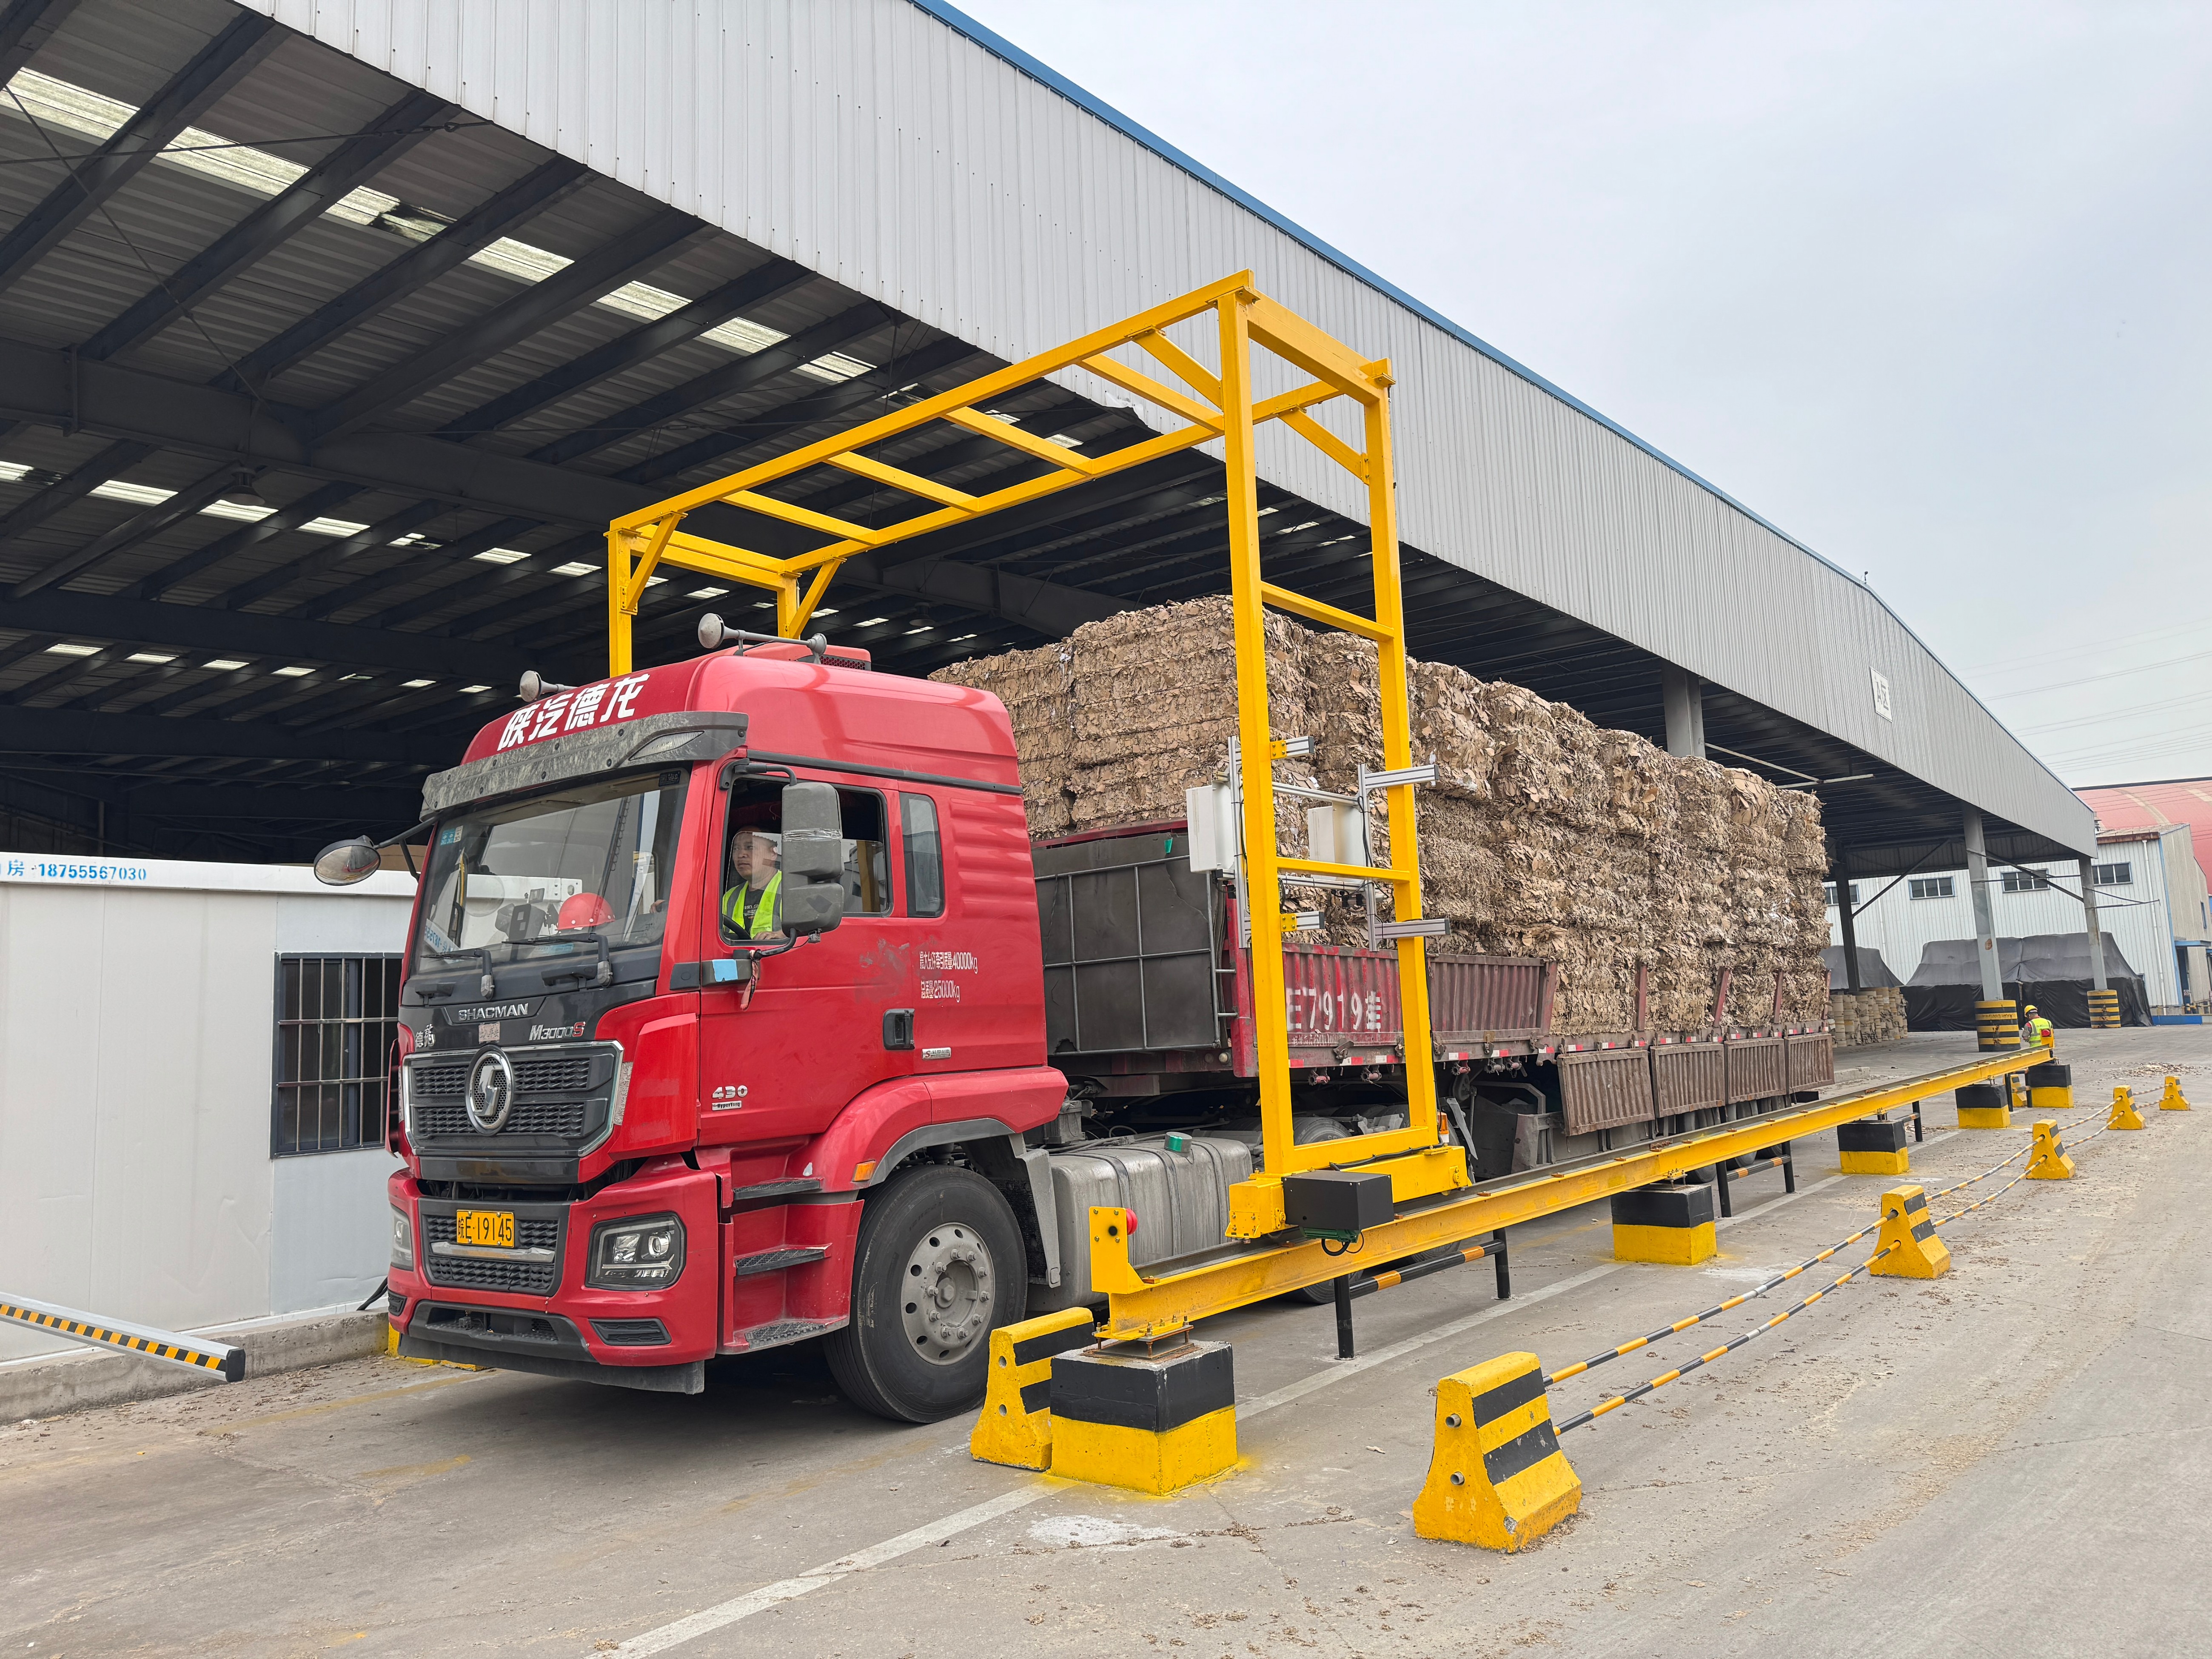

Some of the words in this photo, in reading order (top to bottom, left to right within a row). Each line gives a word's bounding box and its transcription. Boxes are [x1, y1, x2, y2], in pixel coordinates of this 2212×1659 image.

[496, 673, 650, 751] 陕汽德龙
[0, 859, 25, 876] 房
[39, 864, 146, 880] 18755567030
[458, 1003, 529, 1021] SHACMAN
[529, 1021, 586, 1041] M3000S
[712, 1085, 748, 1099] 430
